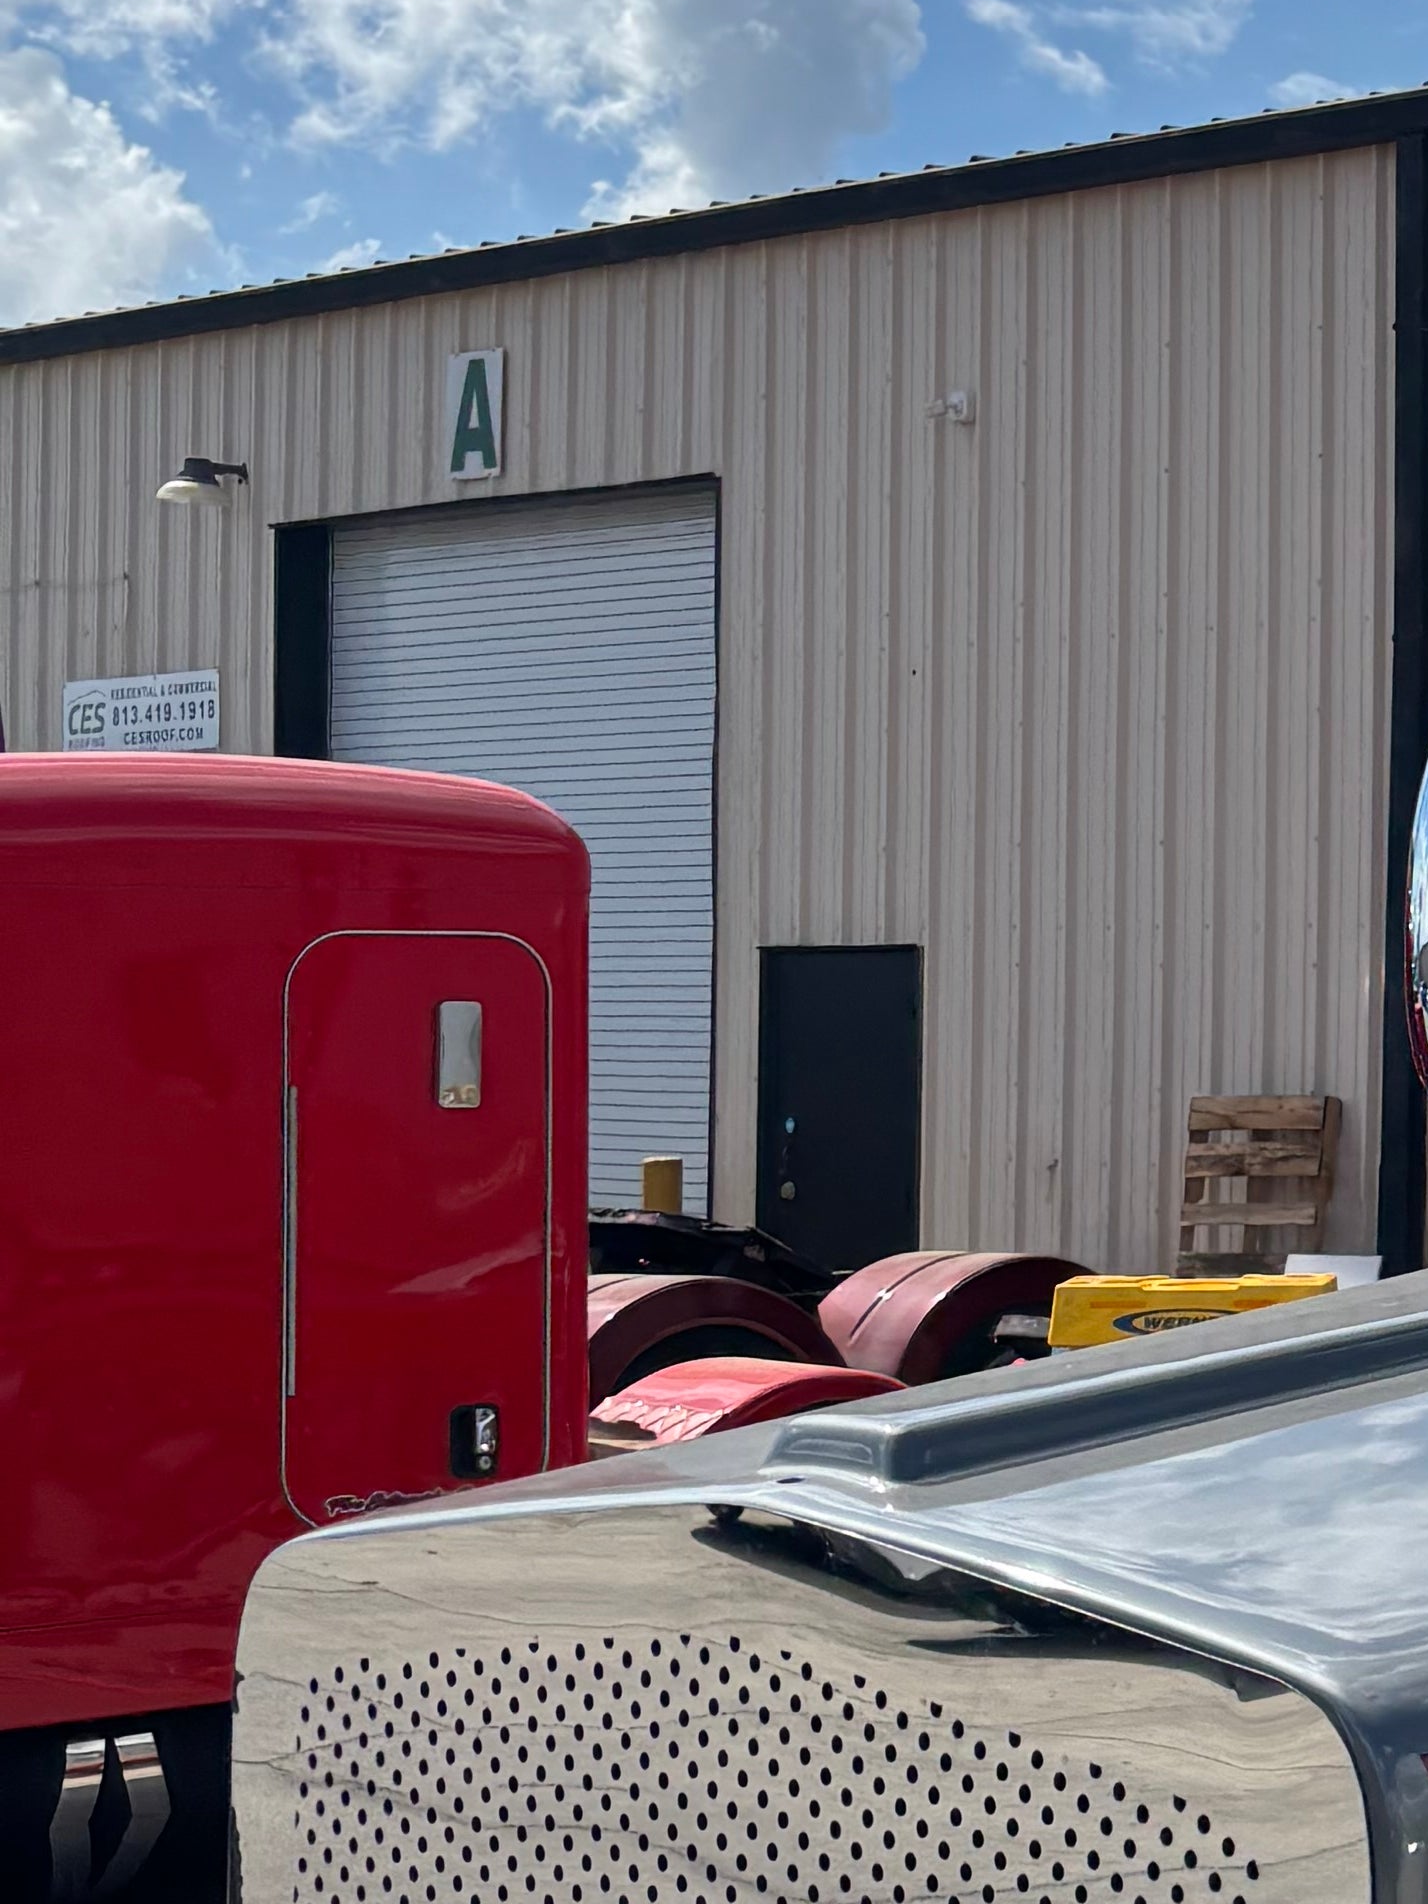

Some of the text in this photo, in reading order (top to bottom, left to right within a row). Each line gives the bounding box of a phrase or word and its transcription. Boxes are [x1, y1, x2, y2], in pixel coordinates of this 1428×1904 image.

[450, 358, 498, 472] A
[160, 684, 166, 696] &
[68, 702, 106, 735] CES
[112, 699, 215, 726] 813.419.1918
[124, 727, 204, 745] CESROOF.COM
